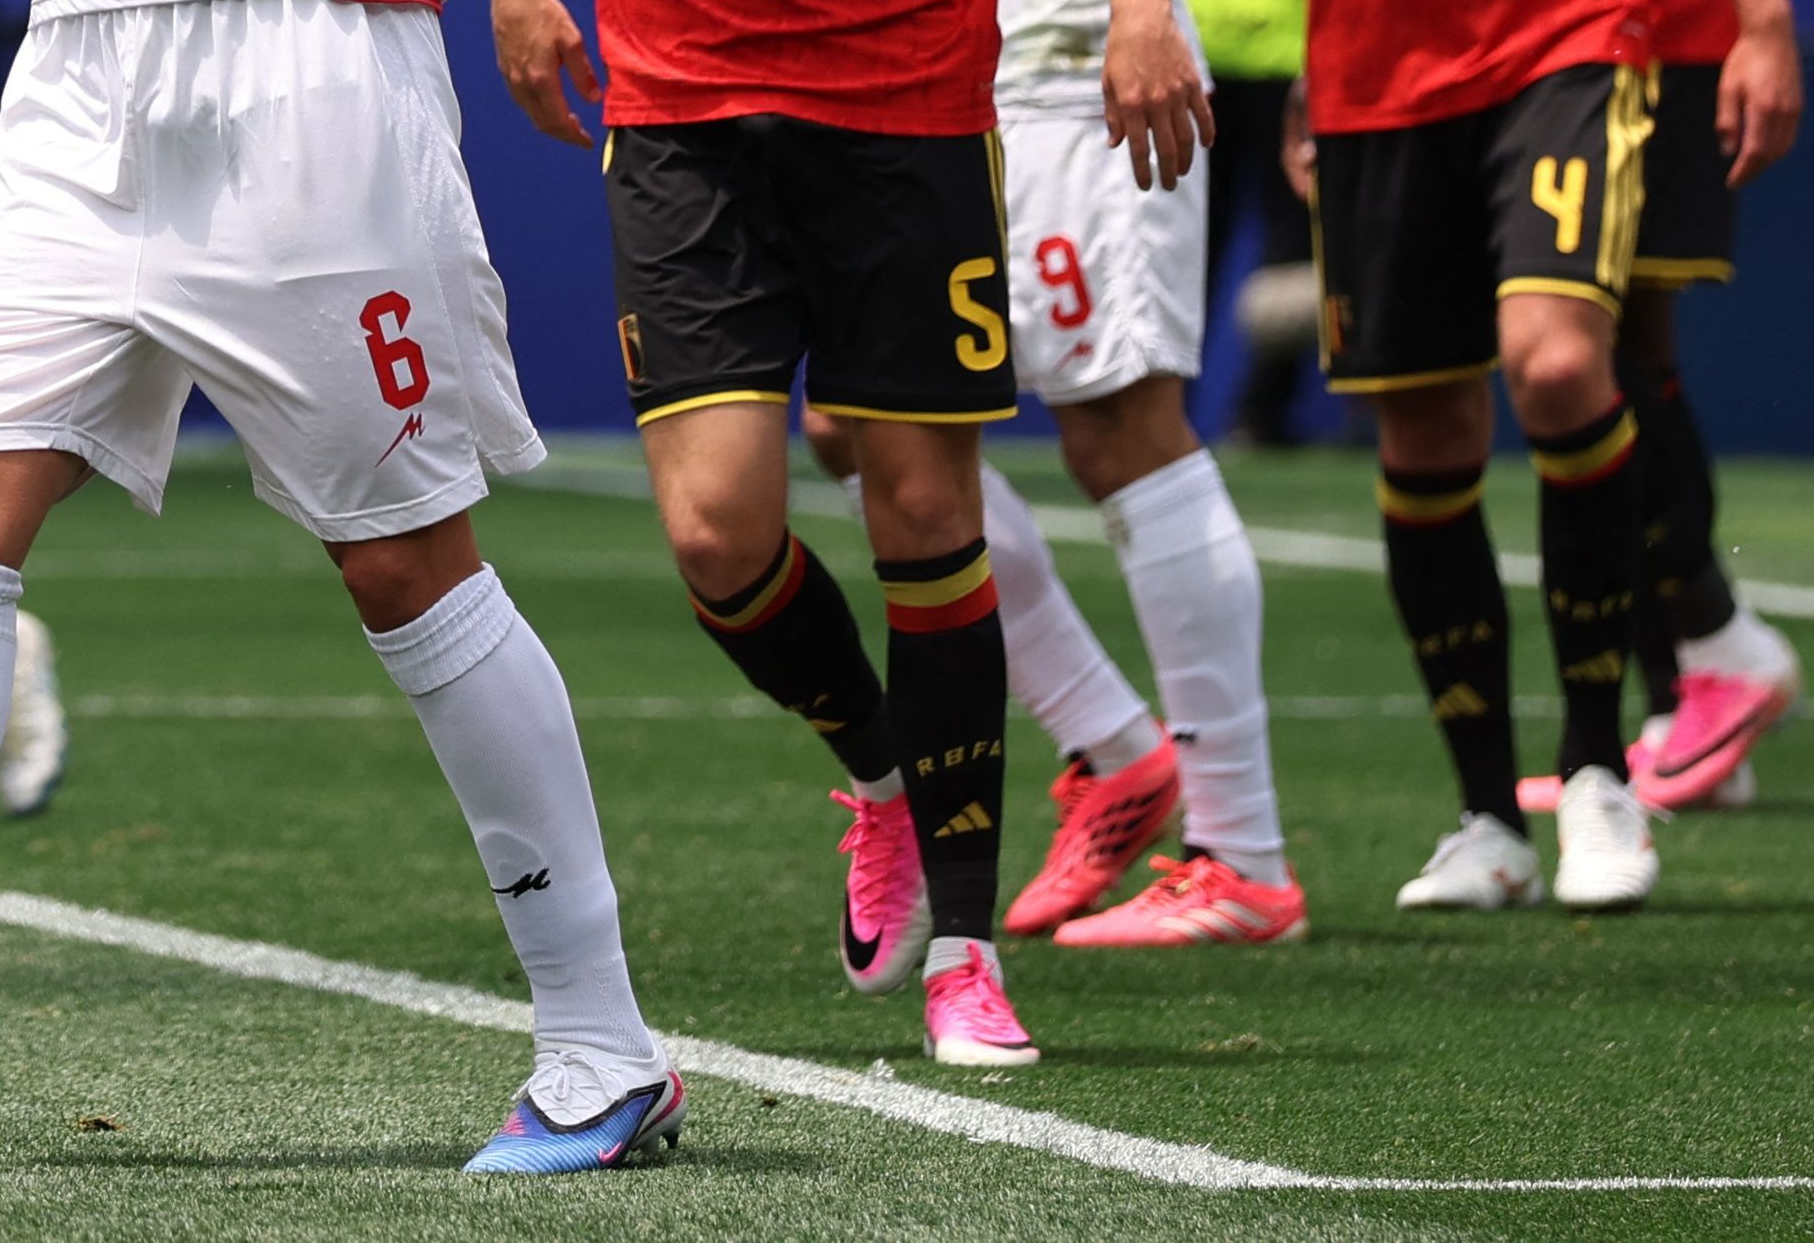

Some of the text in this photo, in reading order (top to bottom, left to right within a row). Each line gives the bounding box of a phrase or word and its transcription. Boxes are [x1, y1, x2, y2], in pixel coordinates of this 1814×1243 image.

[1531, 155, 1588, 254] 4
[948, 256, 1008, 371] 5
[1036, 233, 1094, 330] 9
[359, 290, 430, 411] 6
[916, 739, 1002, 778] RBFA
